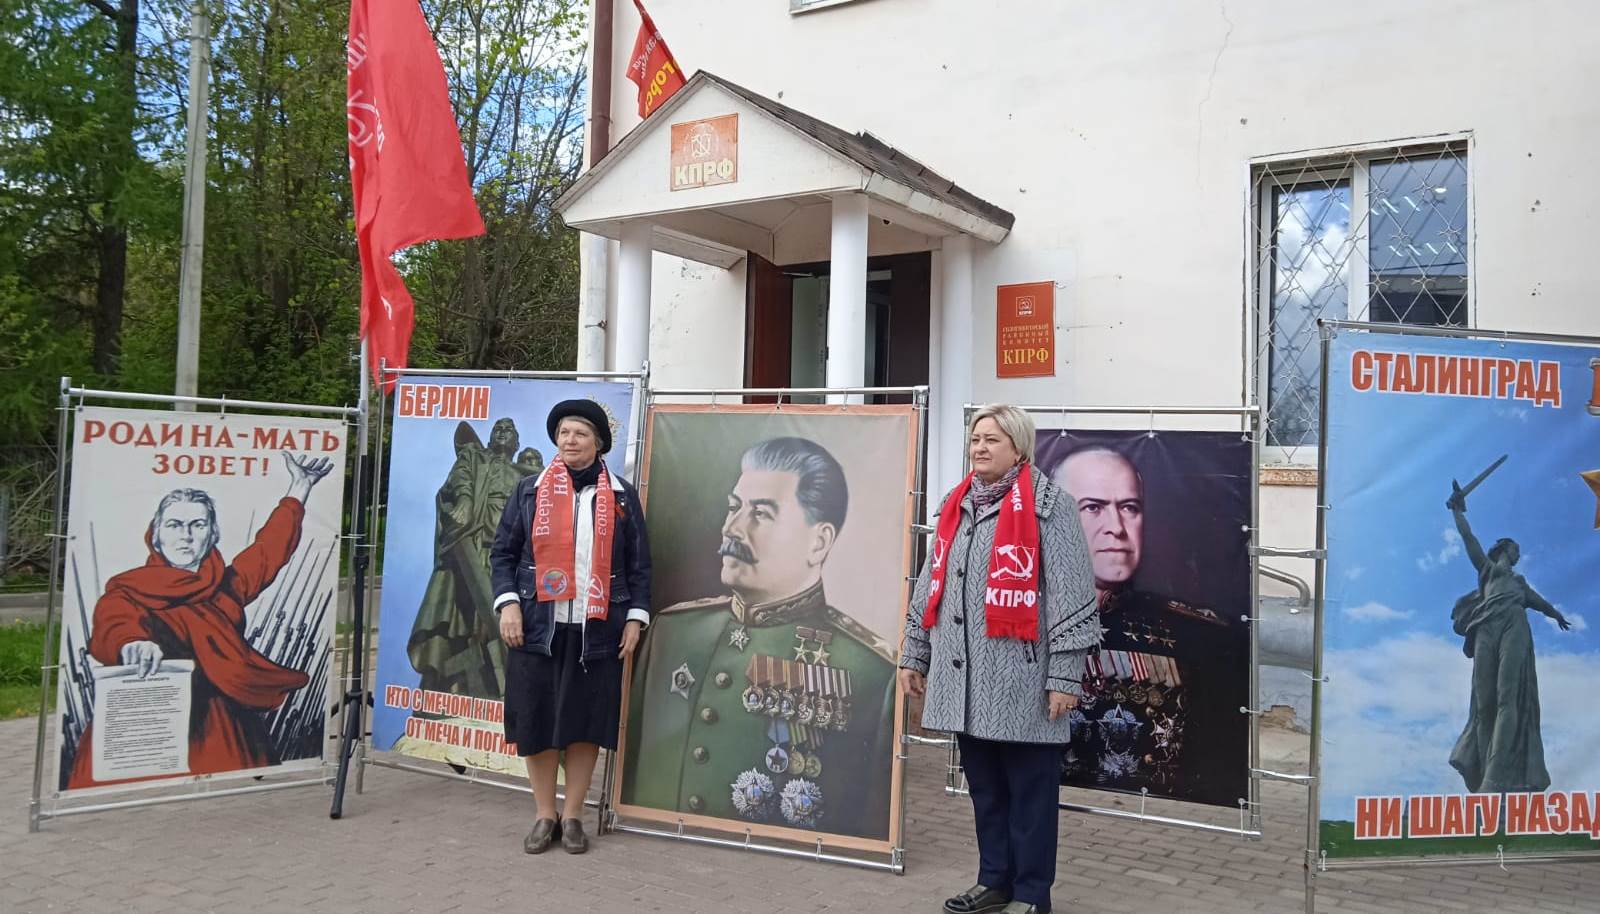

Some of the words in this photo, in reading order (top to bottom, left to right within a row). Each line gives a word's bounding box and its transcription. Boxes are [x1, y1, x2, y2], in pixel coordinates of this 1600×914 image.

[674, 158, 734, 186] КПРФ
[1003, 347, 1049, 364] КПРФ
[1351, 351, 1561, 407] СТАЛИНГРАД
[399, 384, 491, 420] БЕРЛИН
[83, 420, 340, 451] РОДИНА-МАТЬ
[152, 454, 270, 476] ЗОВЕТ!
[985, 588, 1037, 608] КПРФ
[385, 685, 411, 709] КТО
[412, 688, 423, 711] С
[423, 690, 473, 718] МЕЧОМ
[474, 697, 484, 720] К
[485, 699, 504, 724] НА
[406, 717, 424, 739] ОТ
[424, 720, 460, 746] МЕЧА
[462, 726, 473, 749] И
[1355, 796, 1402, 838] НИ
[1409, 794, 1501, 837] ШАГУ
